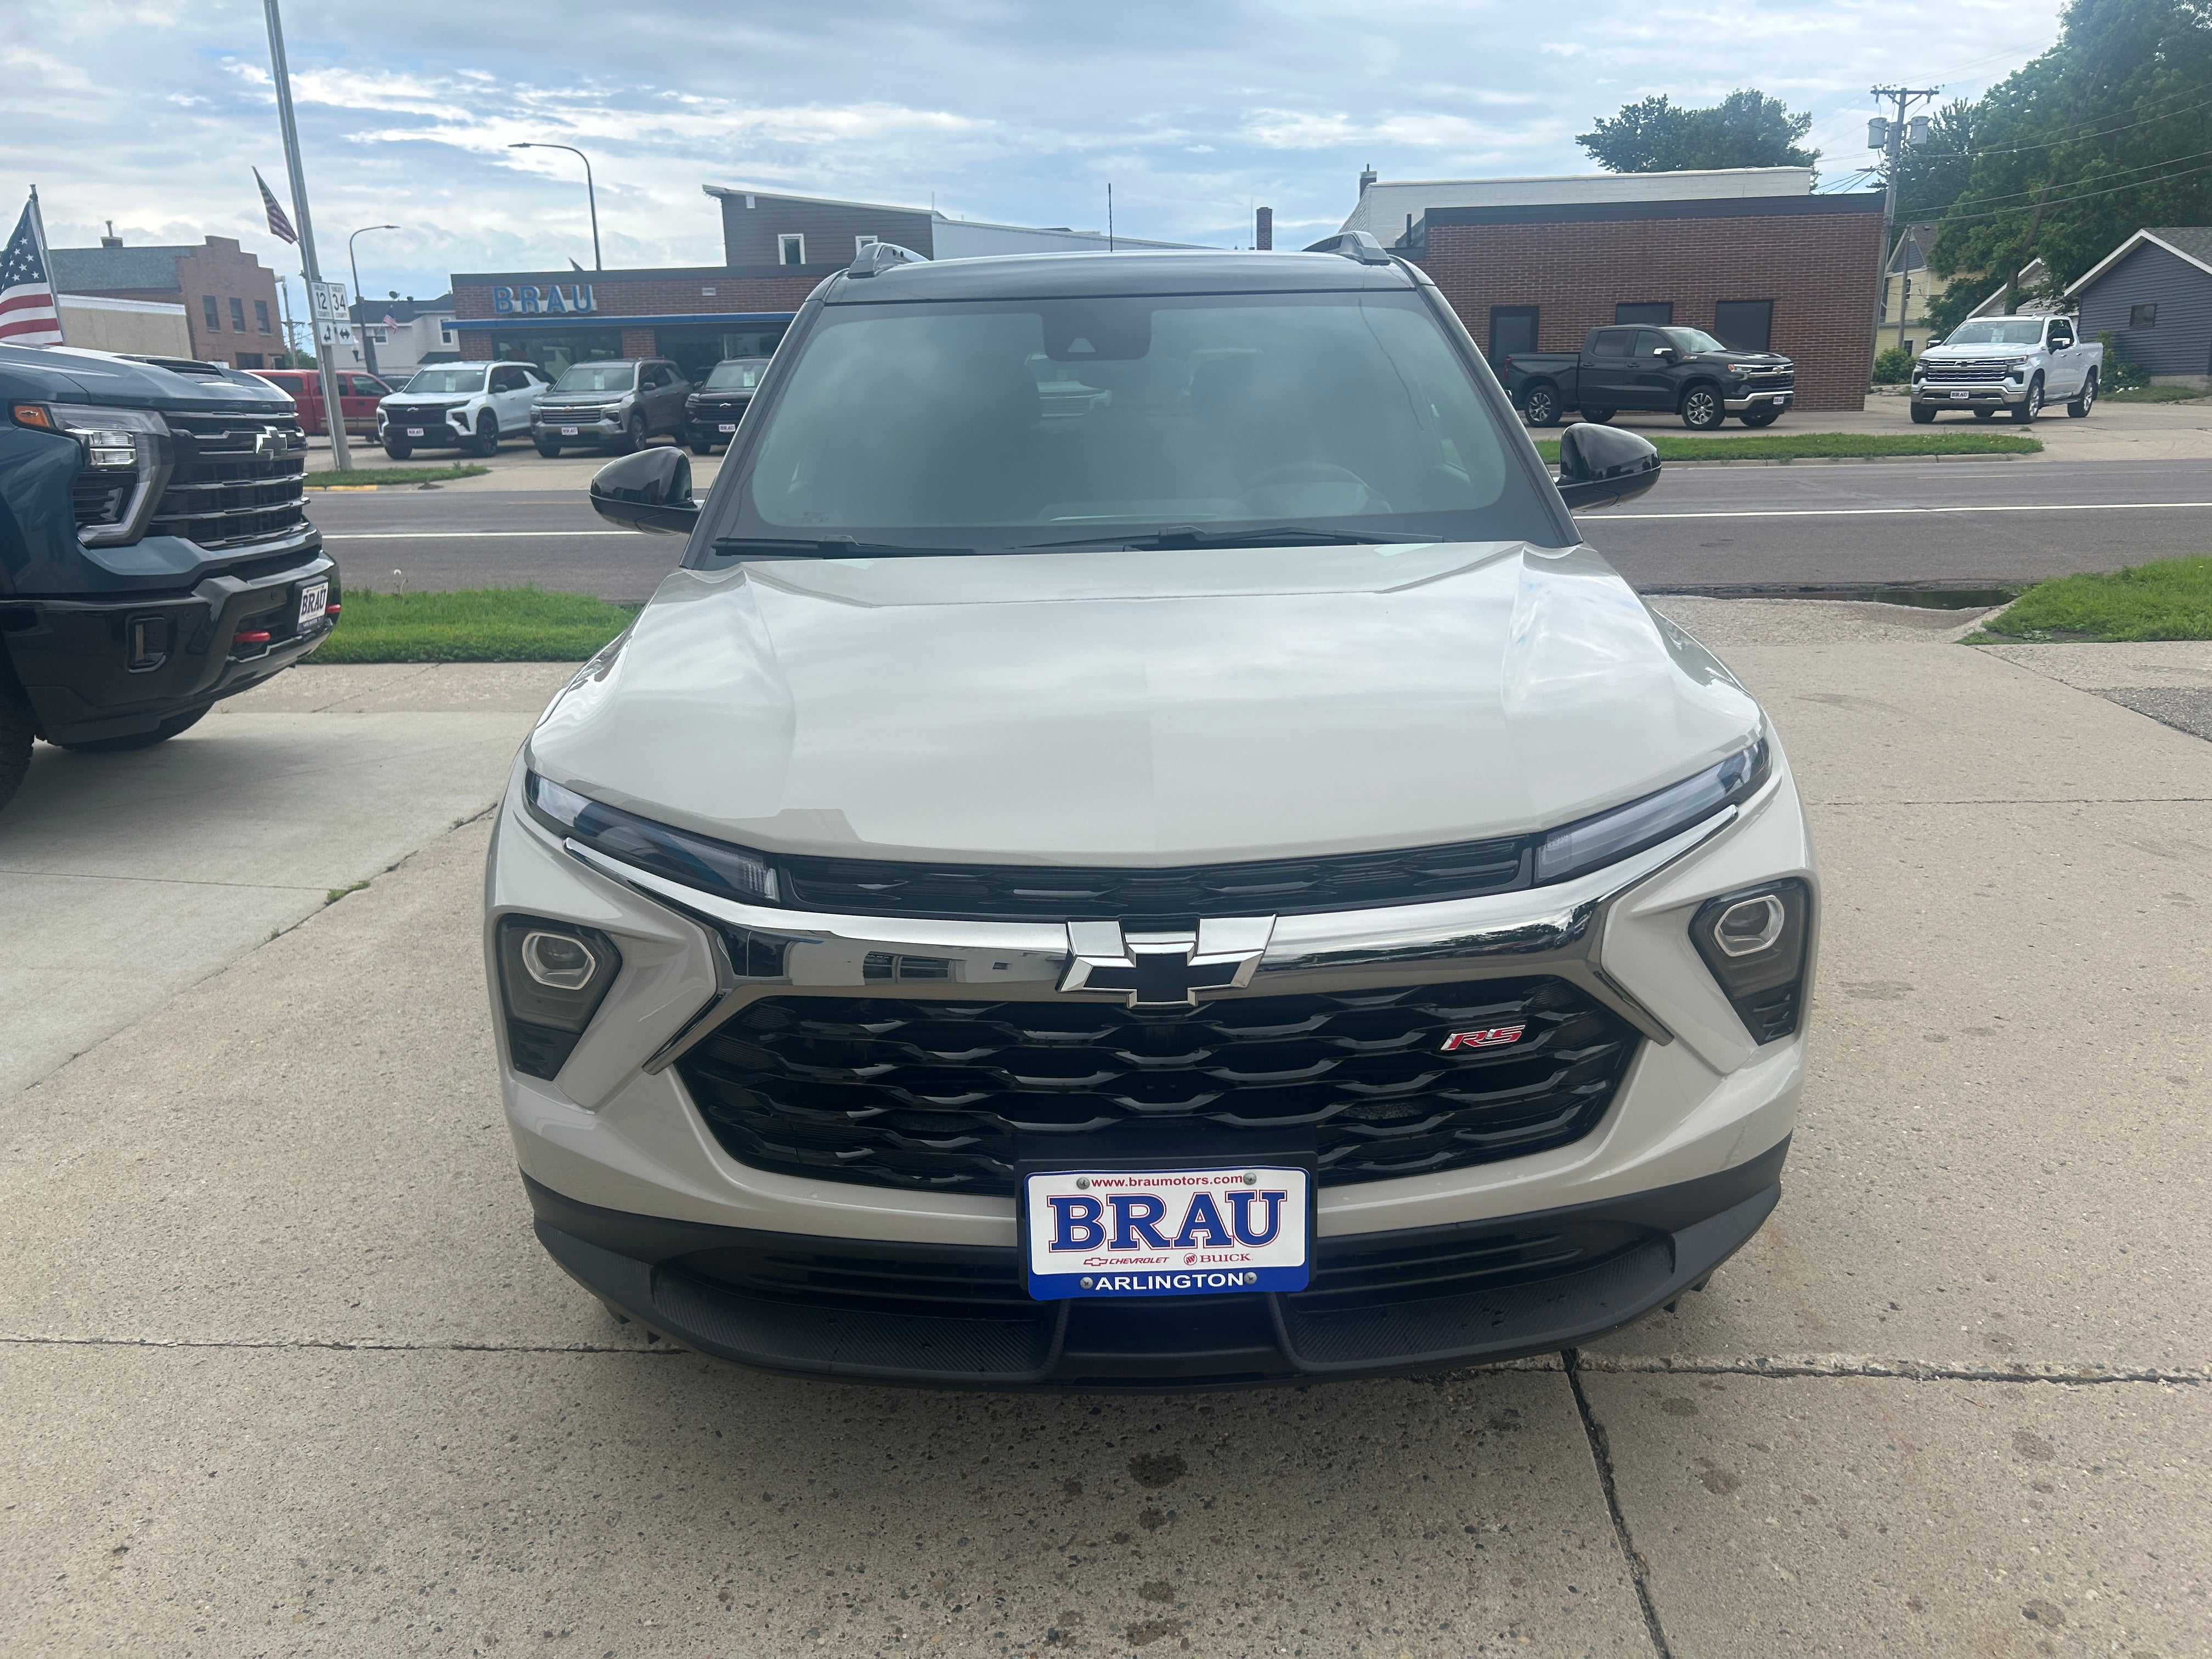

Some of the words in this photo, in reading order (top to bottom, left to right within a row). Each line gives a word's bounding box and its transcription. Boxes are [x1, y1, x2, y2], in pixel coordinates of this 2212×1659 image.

[316, 292, 328, 309] 12
[332, 294, 346, 311] 34
[494, 284, 594, 314] BRAU
[301, 589, 327, 616] BRAU
[1440, 1024, 1526, 1051] RS
[1091, 1175, 1243, 1188] www.braumotors.com
[1047, 1189, 1288, 1253] BRAU
[1109, 1256, 1170, 1265] CHEVROLET
[1199, 1254, 1251, 1262] BUICK
[1095, 1272, 1244, 1290] ARLINGTON
